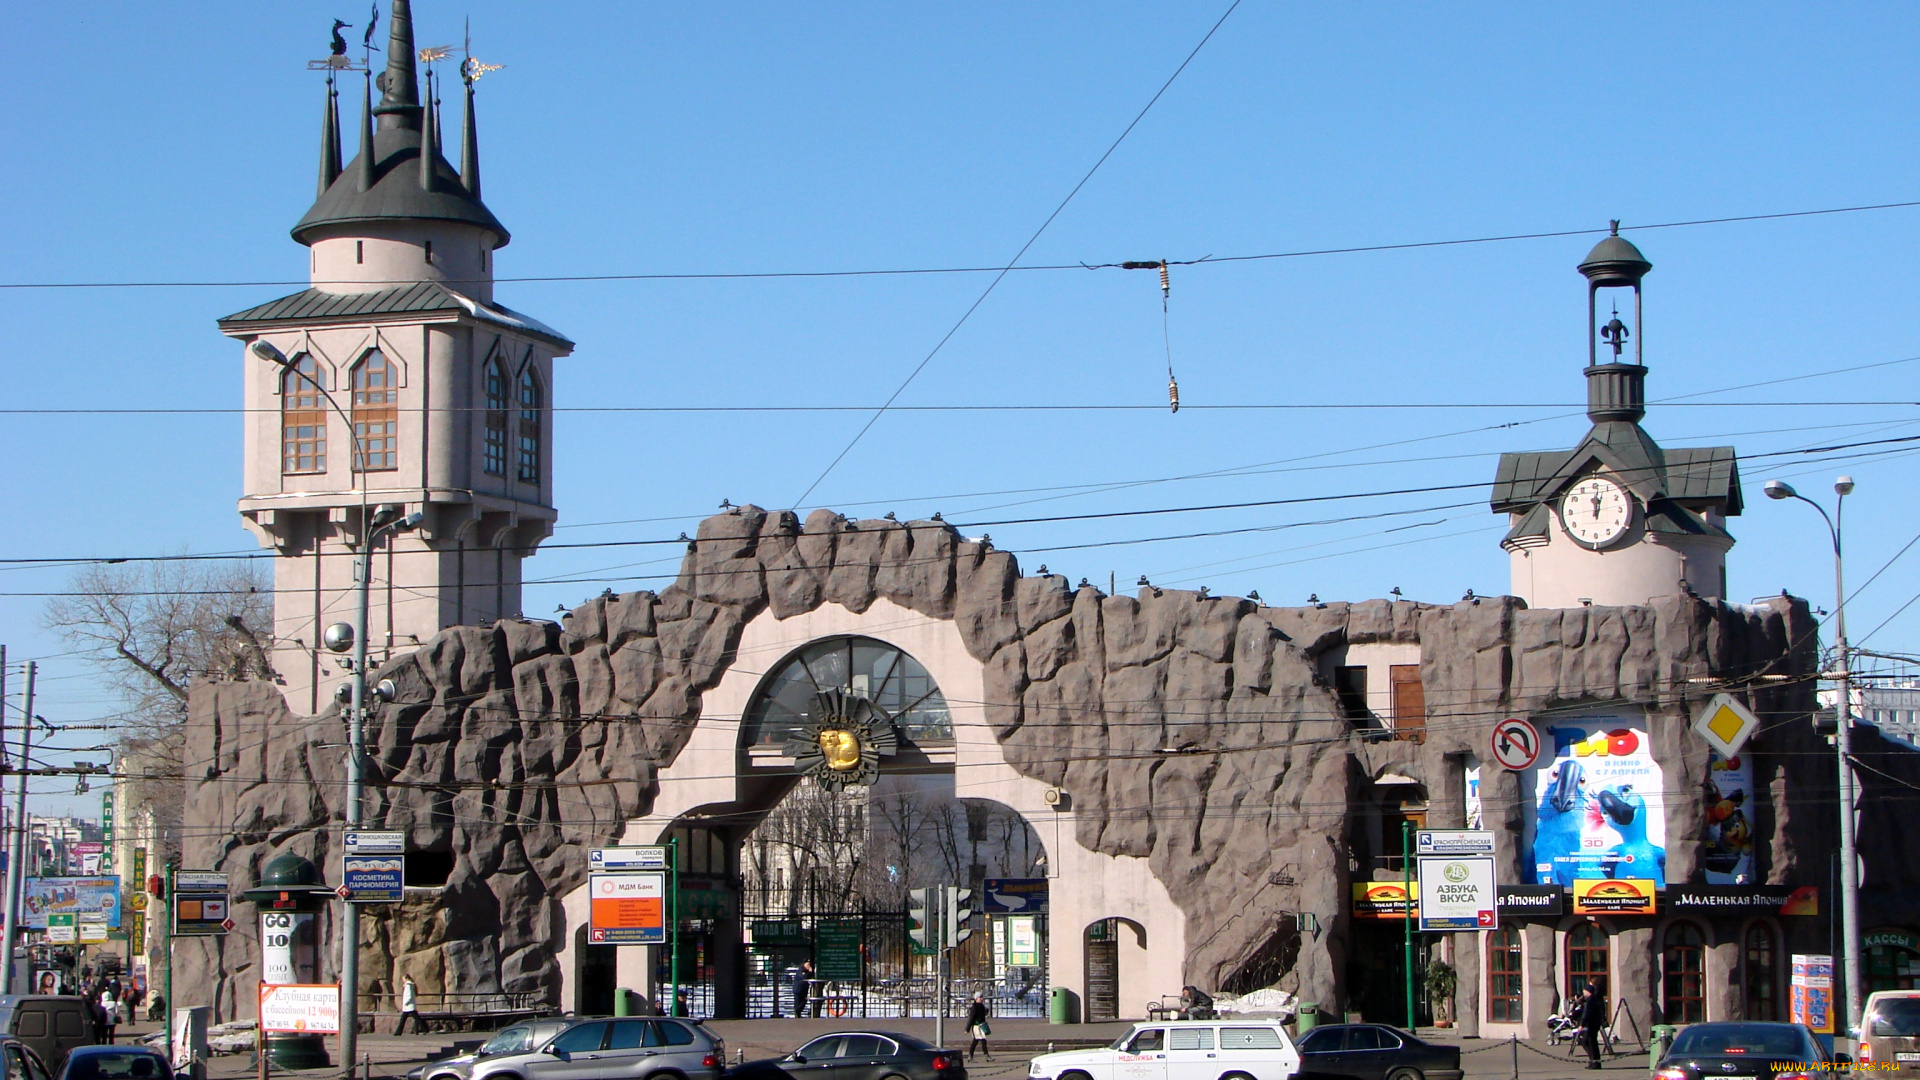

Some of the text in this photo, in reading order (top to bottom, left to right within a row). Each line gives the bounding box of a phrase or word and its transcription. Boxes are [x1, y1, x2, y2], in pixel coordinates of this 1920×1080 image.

[1546, 726, 1640, 757] РИО
[104, 794, 113, 867] АПТЕКА
[1584, 839, 1603, 848] 3D
[1436, 884, 1479, 894] АЗБУКА
[1439, 894, 1476, 903] ВКУСА
[265, 913, 290, 928] GQ
[754, 923, 798, 936] ВХОДА НЕТ
[266, 934, 289, 947] 10
[1864, 934, 1910, 946] КАССЫ
[268, 964, 287, 973] 100
[275, 989, 337, 1006] Клубная карта
[270, 1005, 306, 1015] бассейном
